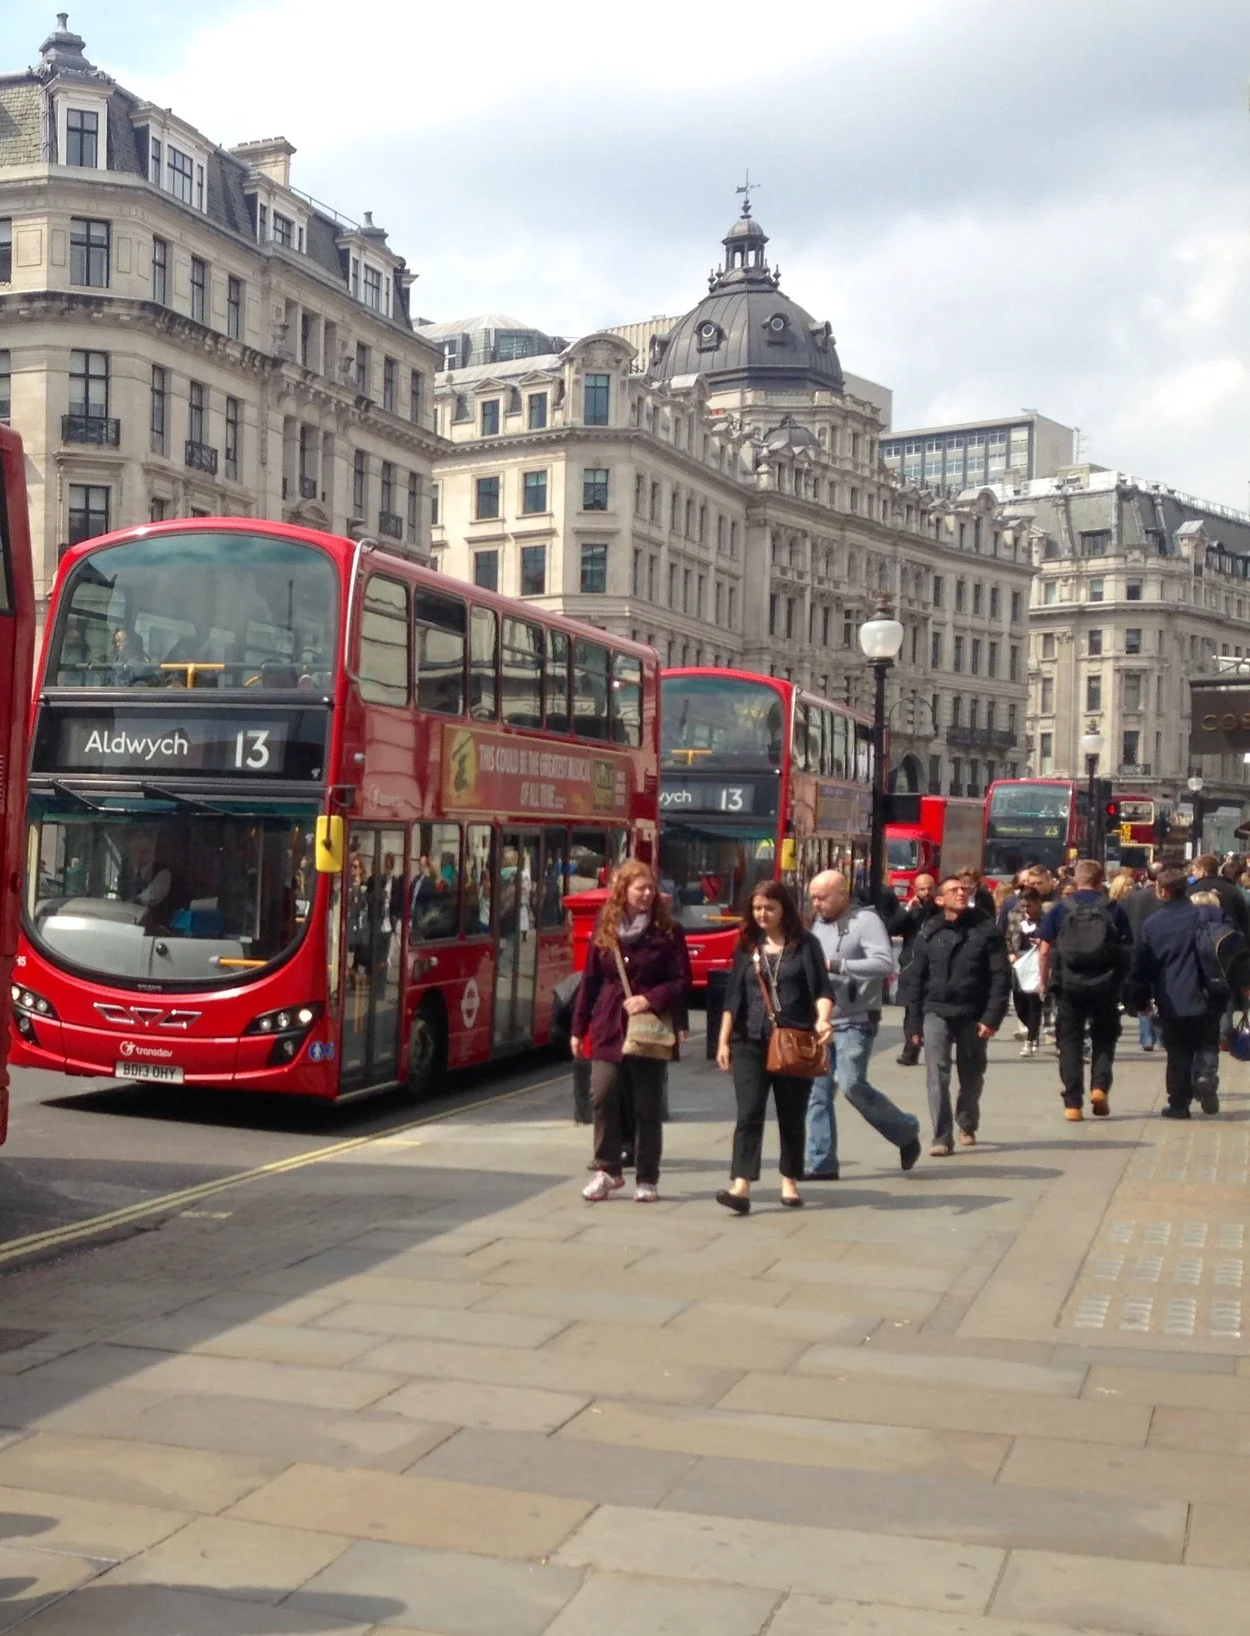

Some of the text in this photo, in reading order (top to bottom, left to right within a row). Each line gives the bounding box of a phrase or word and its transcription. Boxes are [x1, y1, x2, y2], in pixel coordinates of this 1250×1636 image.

[84, 730, 270, 769] Aldwych 13
[721, 788, 743, 810] 13
[136, 1045, 173, 1058] transdev
[123, 1063, 176, 1079] BD13 OHY
